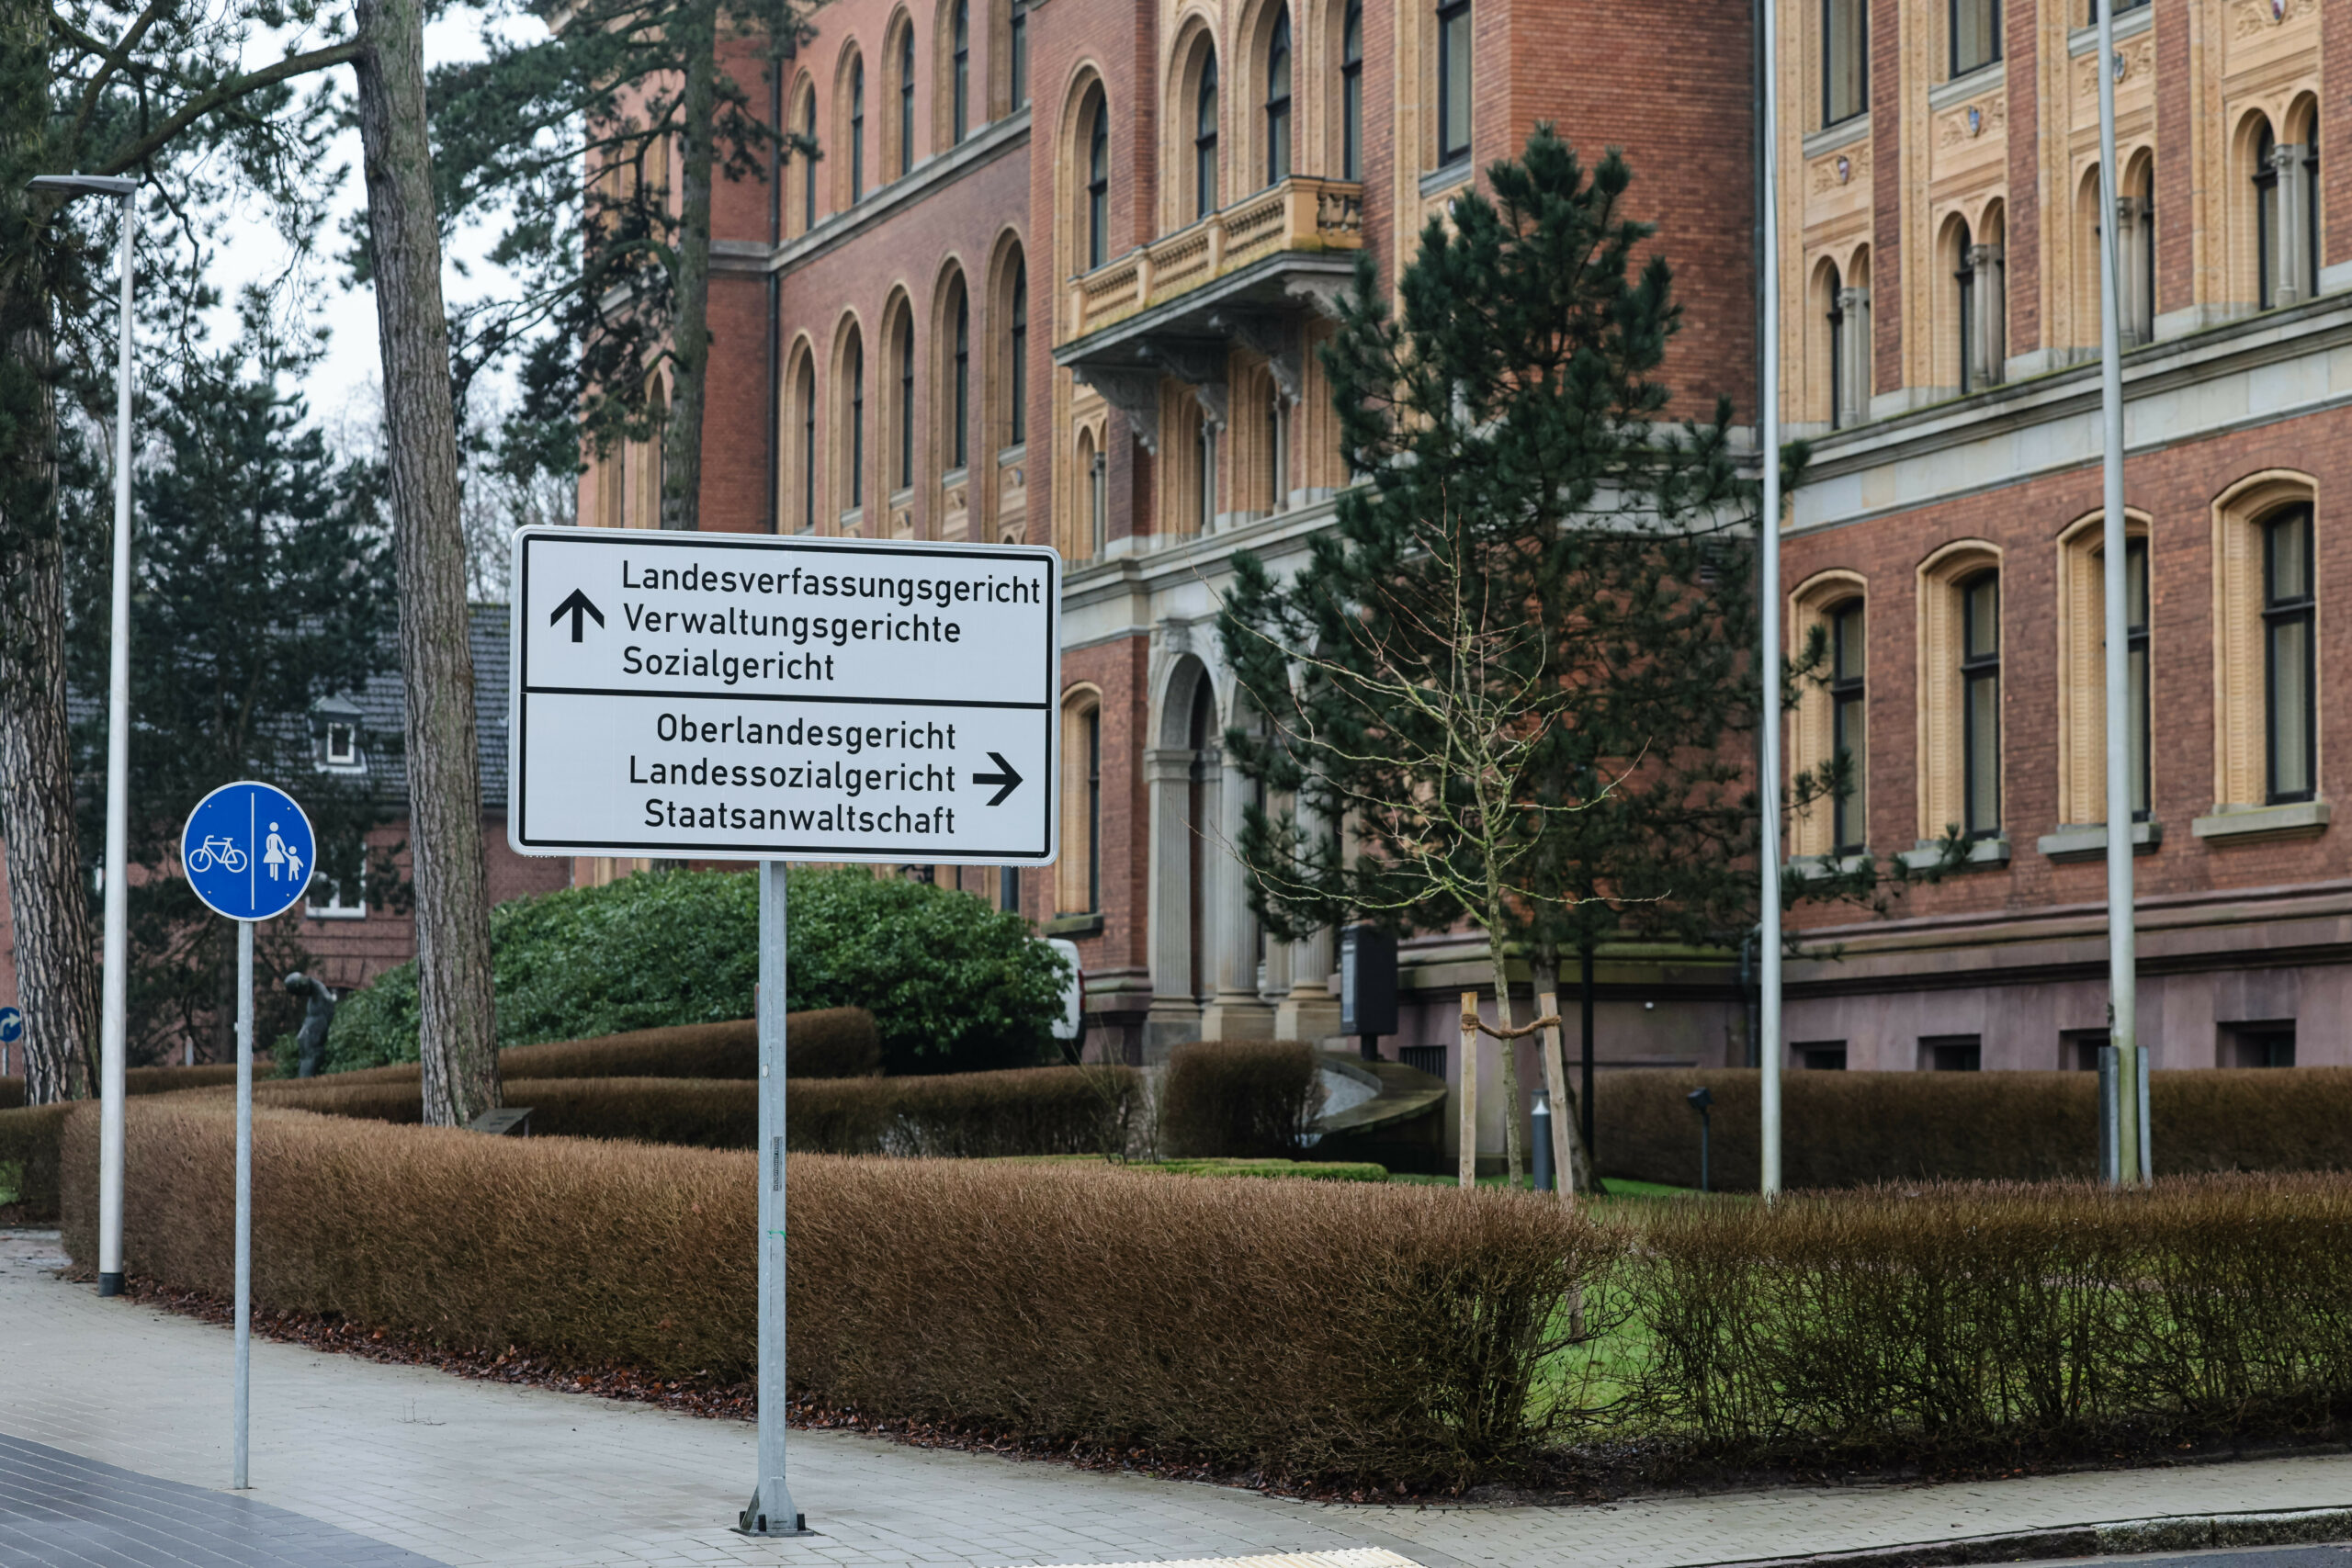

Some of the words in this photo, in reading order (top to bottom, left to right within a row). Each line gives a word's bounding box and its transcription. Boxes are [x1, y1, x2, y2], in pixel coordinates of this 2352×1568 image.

[624, 560, 1040, 607] Landesverfassungsgericht
[624, 604, 961, 646] Verwaltungsgerichte
[623, 646, 834, 685] Sozialgericht
[658, 714, 956, 754] Oberlandesgericht
[630, 755, 956, 796] Landessozialgericht
[645, 799, 955, 834] Staatsanwaltschaft
